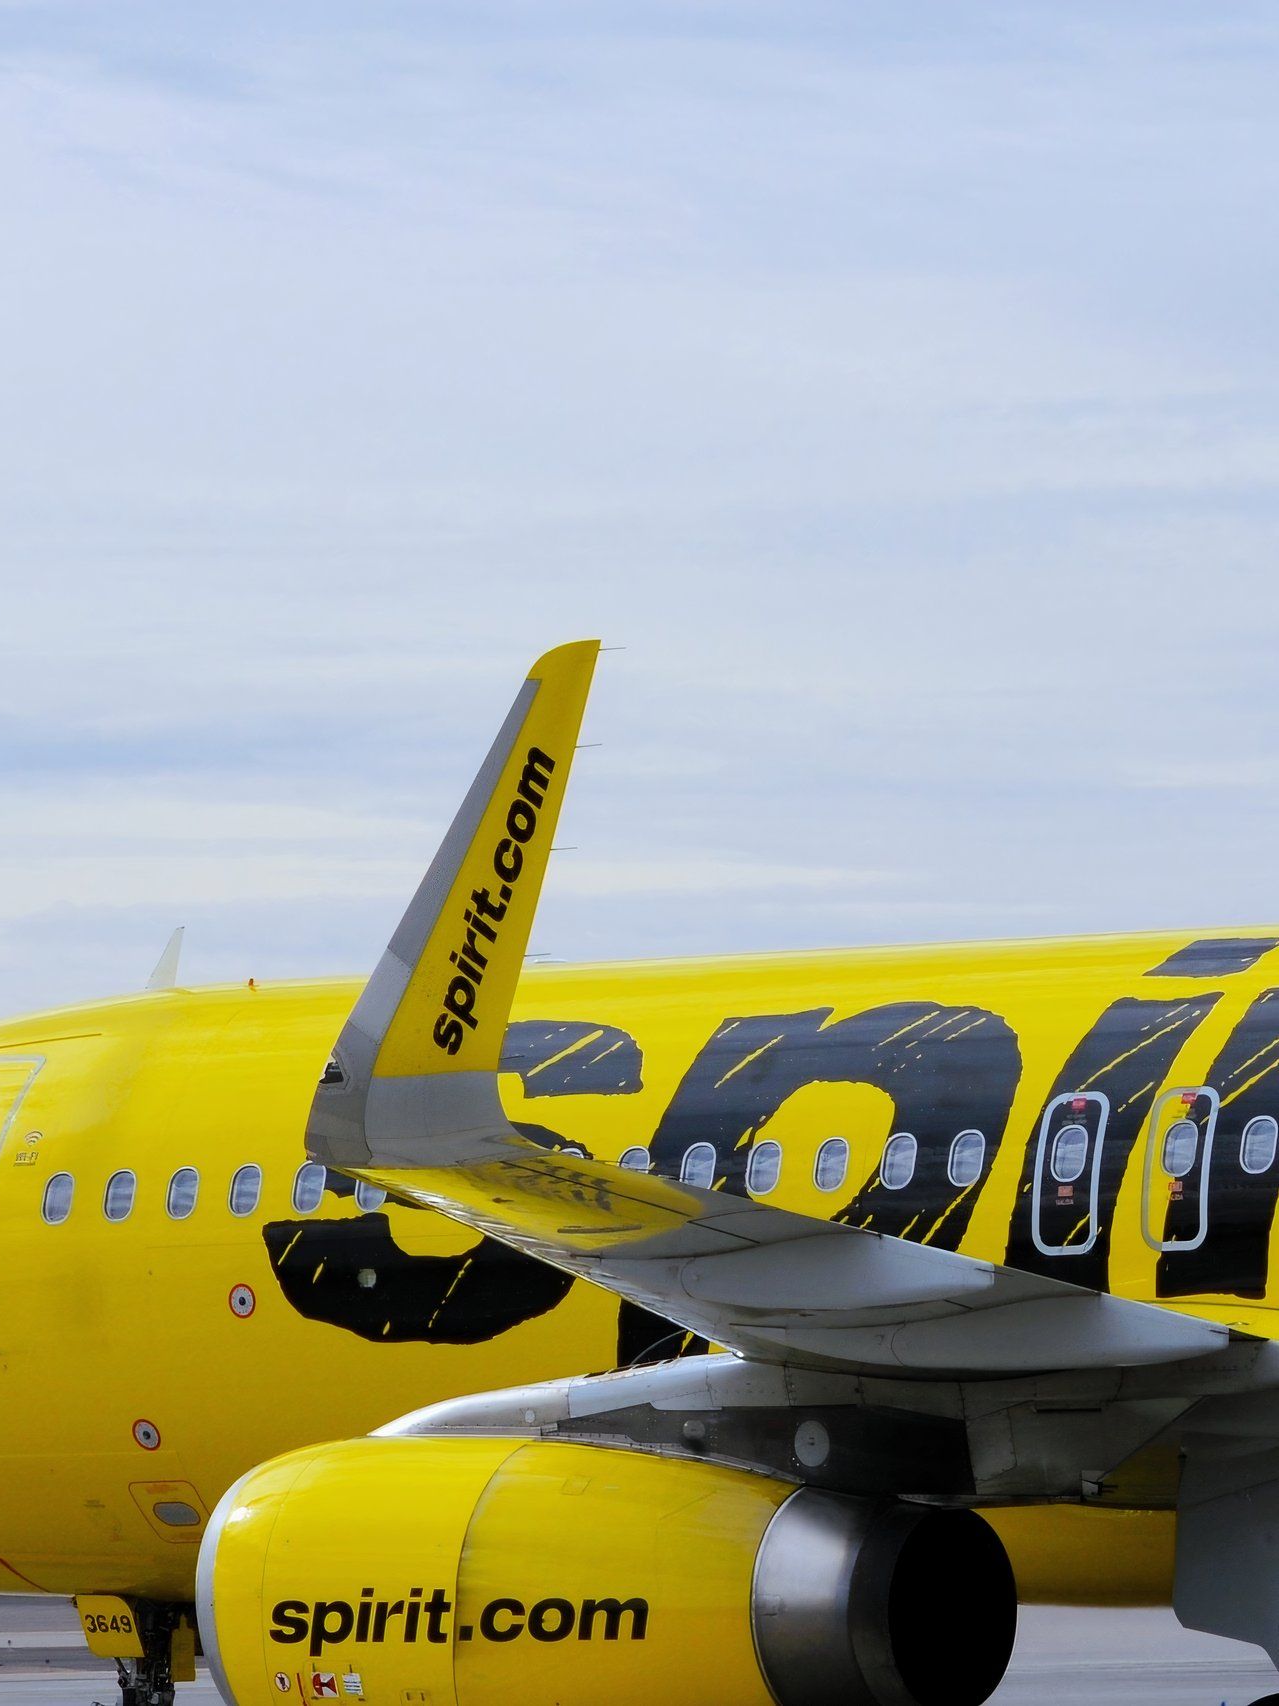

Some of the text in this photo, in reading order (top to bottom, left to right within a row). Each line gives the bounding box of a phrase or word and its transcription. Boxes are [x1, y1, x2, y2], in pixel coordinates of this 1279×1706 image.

[432, 746, 556, 1056] spirit.com
[84, 1614, 133, 1634] 3649
[269, 1587, 650, 1657] spirit.com
